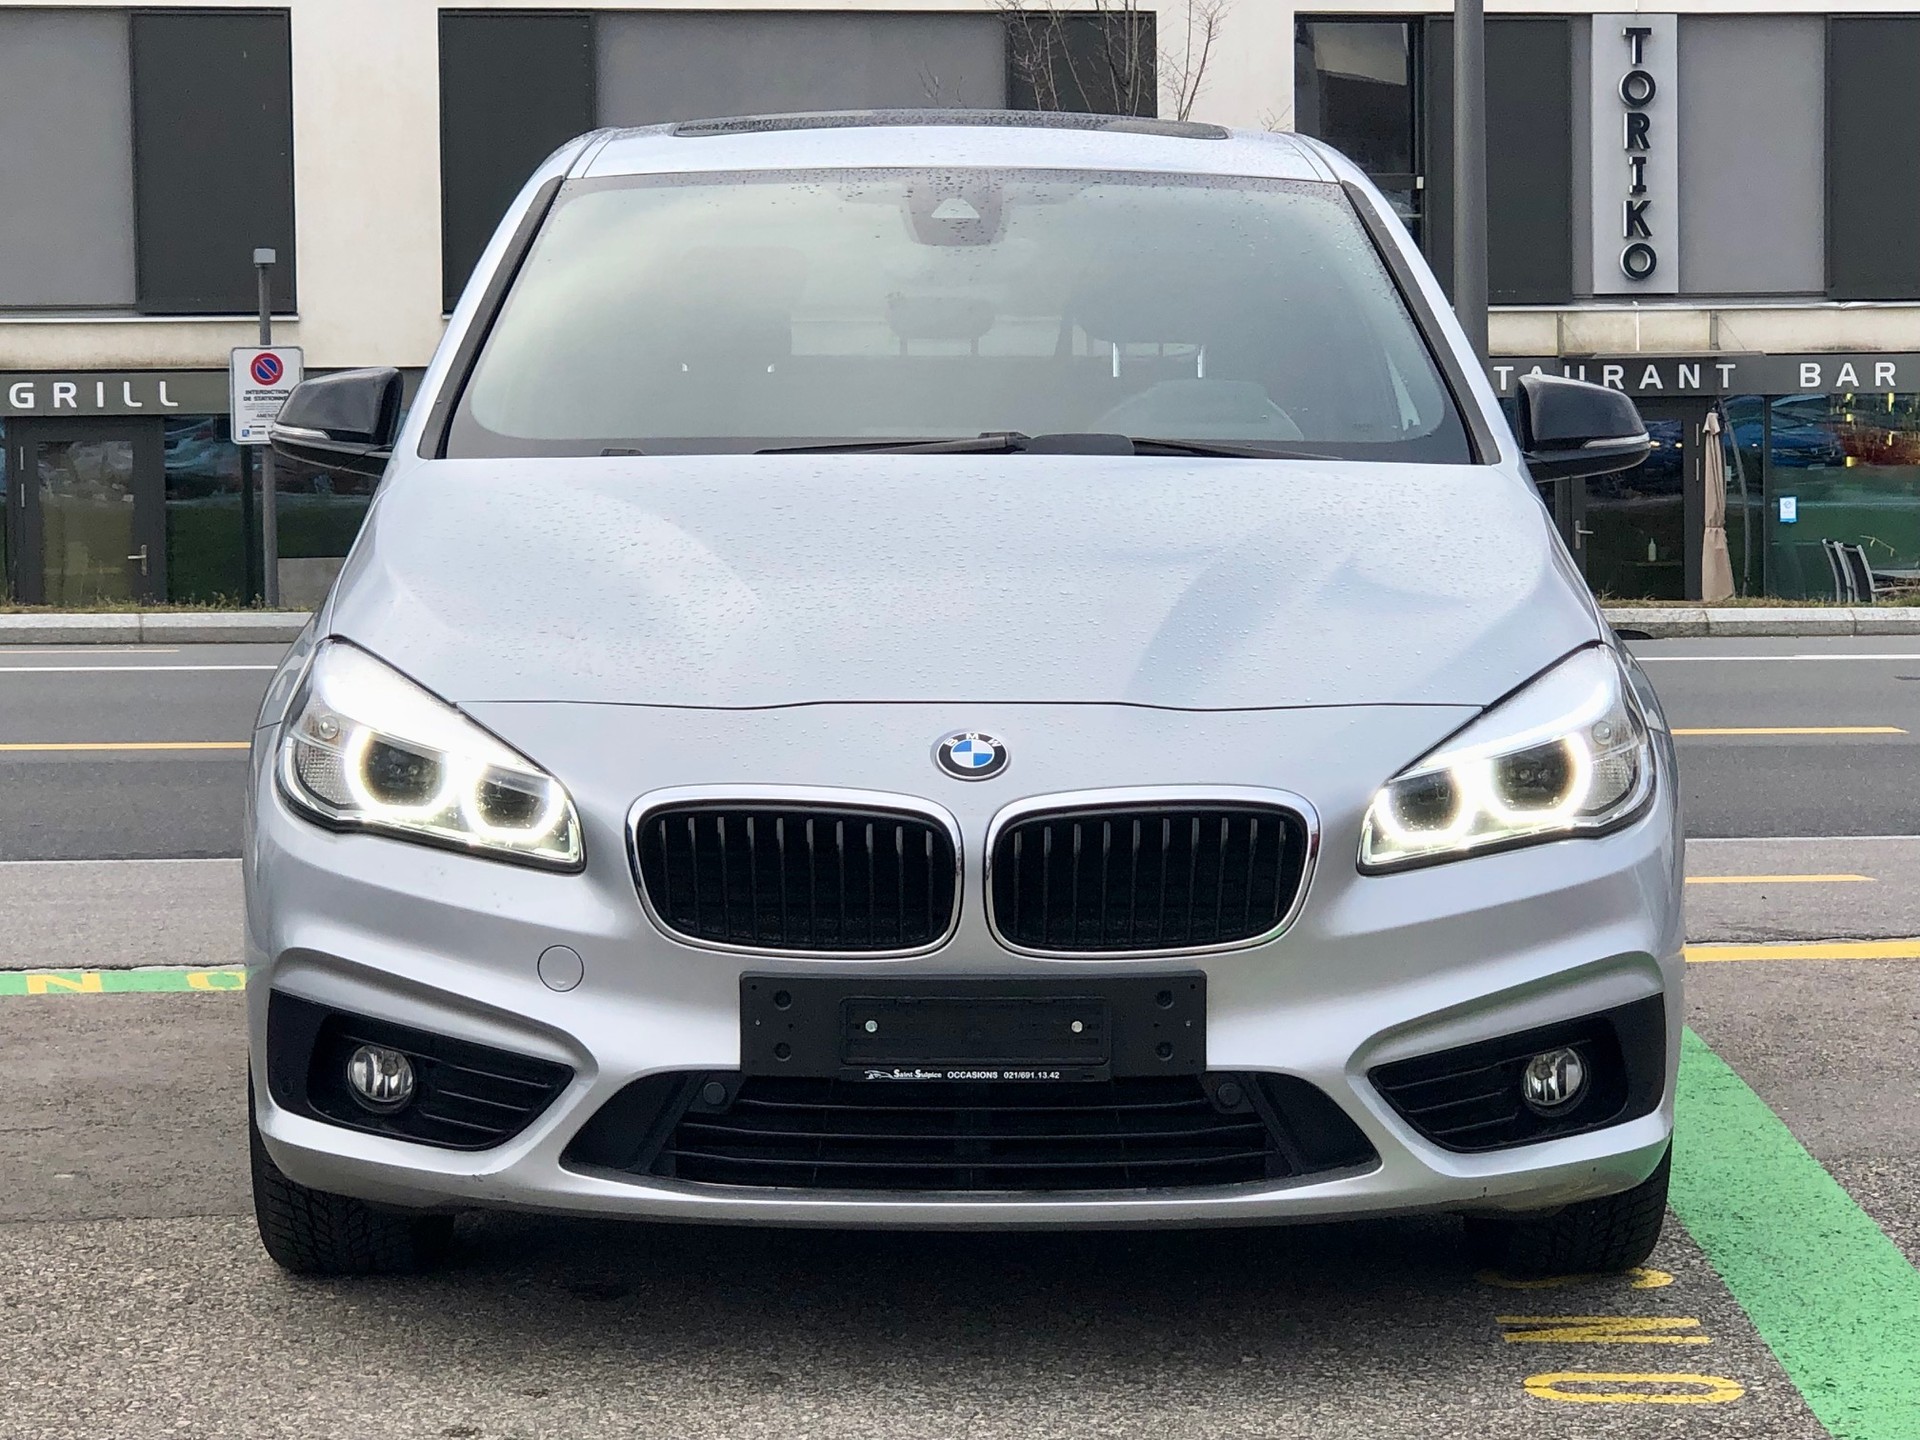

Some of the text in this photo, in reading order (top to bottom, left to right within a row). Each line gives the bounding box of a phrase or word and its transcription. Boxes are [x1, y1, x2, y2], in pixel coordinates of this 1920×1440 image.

[1618, 27, 1657, 280] TORIKO
[1800, 361, 1897, 388] BAR
[9, 380, 179, 409] GRILL
[893, 1069, 1060, 1080] Saint Sulpice OCCASIONS 021/691.13.42
